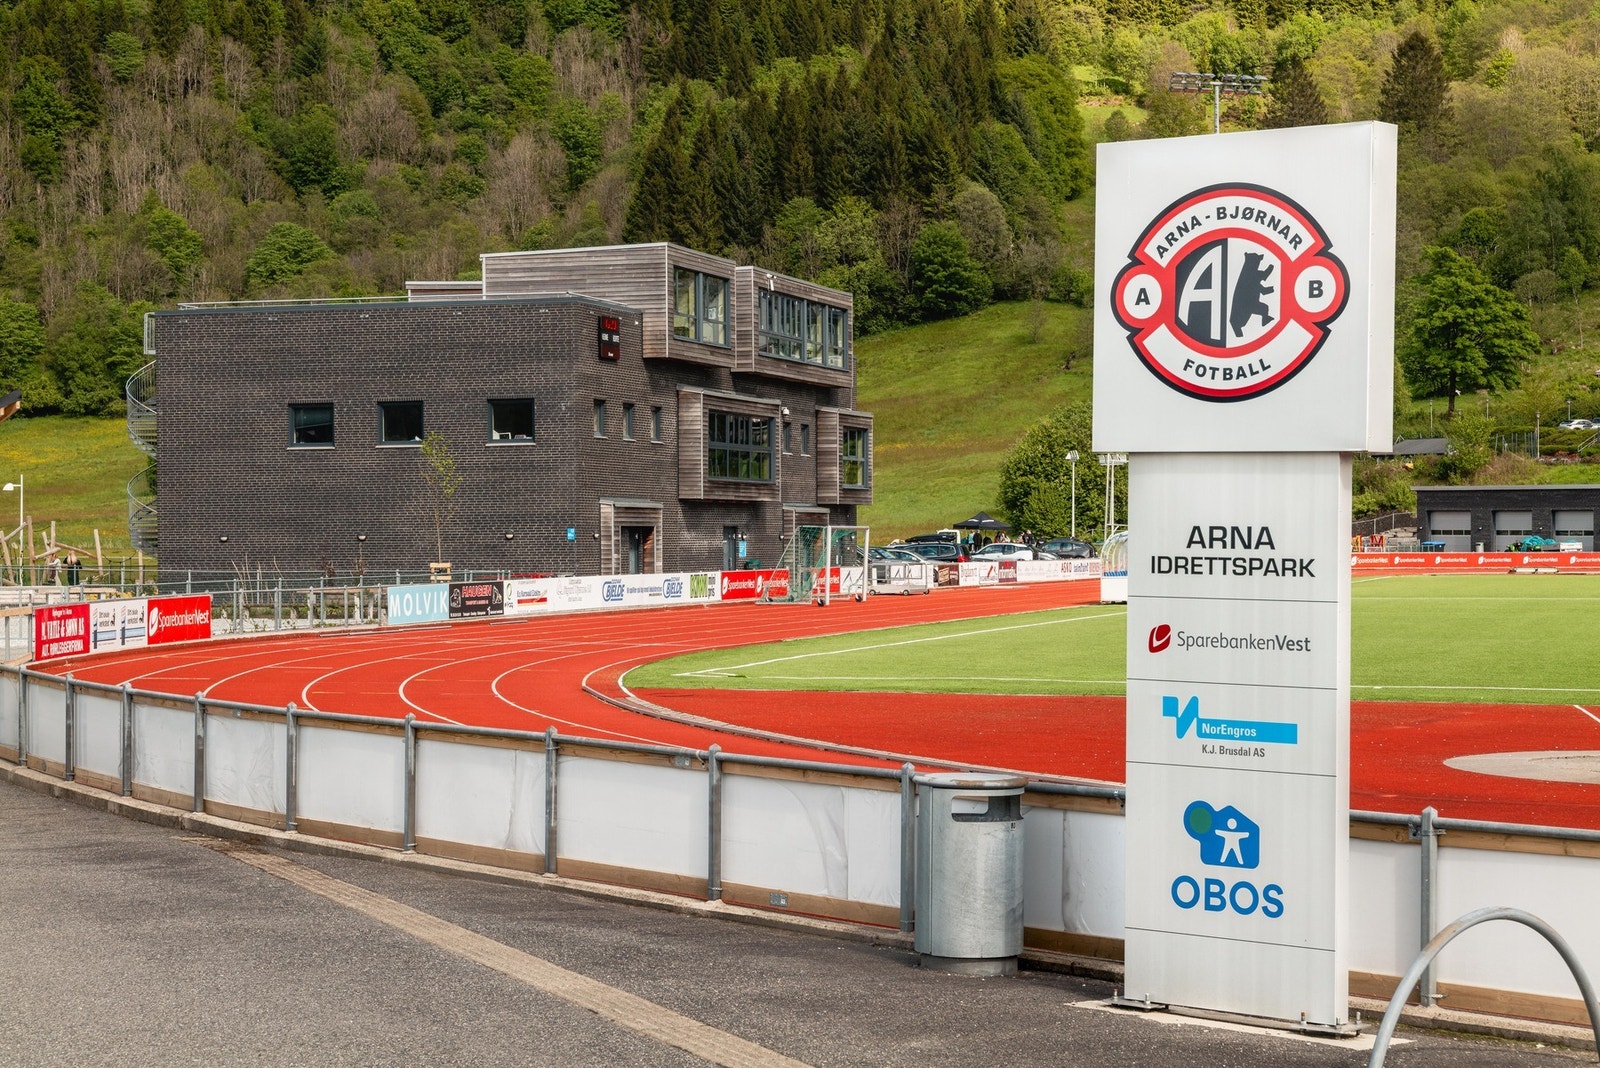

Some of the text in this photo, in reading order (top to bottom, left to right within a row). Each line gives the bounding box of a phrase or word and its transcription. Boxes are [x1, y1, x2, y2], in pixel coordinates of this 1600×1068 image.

[1134, 287, 1151, 306] A
[1308, 279, 1324, 299] B
[1182, 357, 1272, 382] FOTBALL
[1185, 525, 1276, 550] ARNA
[1150, 554, 1316, 578] IDRETTSPARK
[461, 585, 492, 598] HAUGEN
[389, 590, 448, 618] MOLVIK
[158, 609, 209, 632] SparebankenVest
[1176, 630, 1311, 652] SparebankenVest
[1201, 722, 1257, 738] NorEngros
[1201, 744, 1265, 758] K.J. Brusdal AS
[1171, 875, 1285, 919] OBOS
